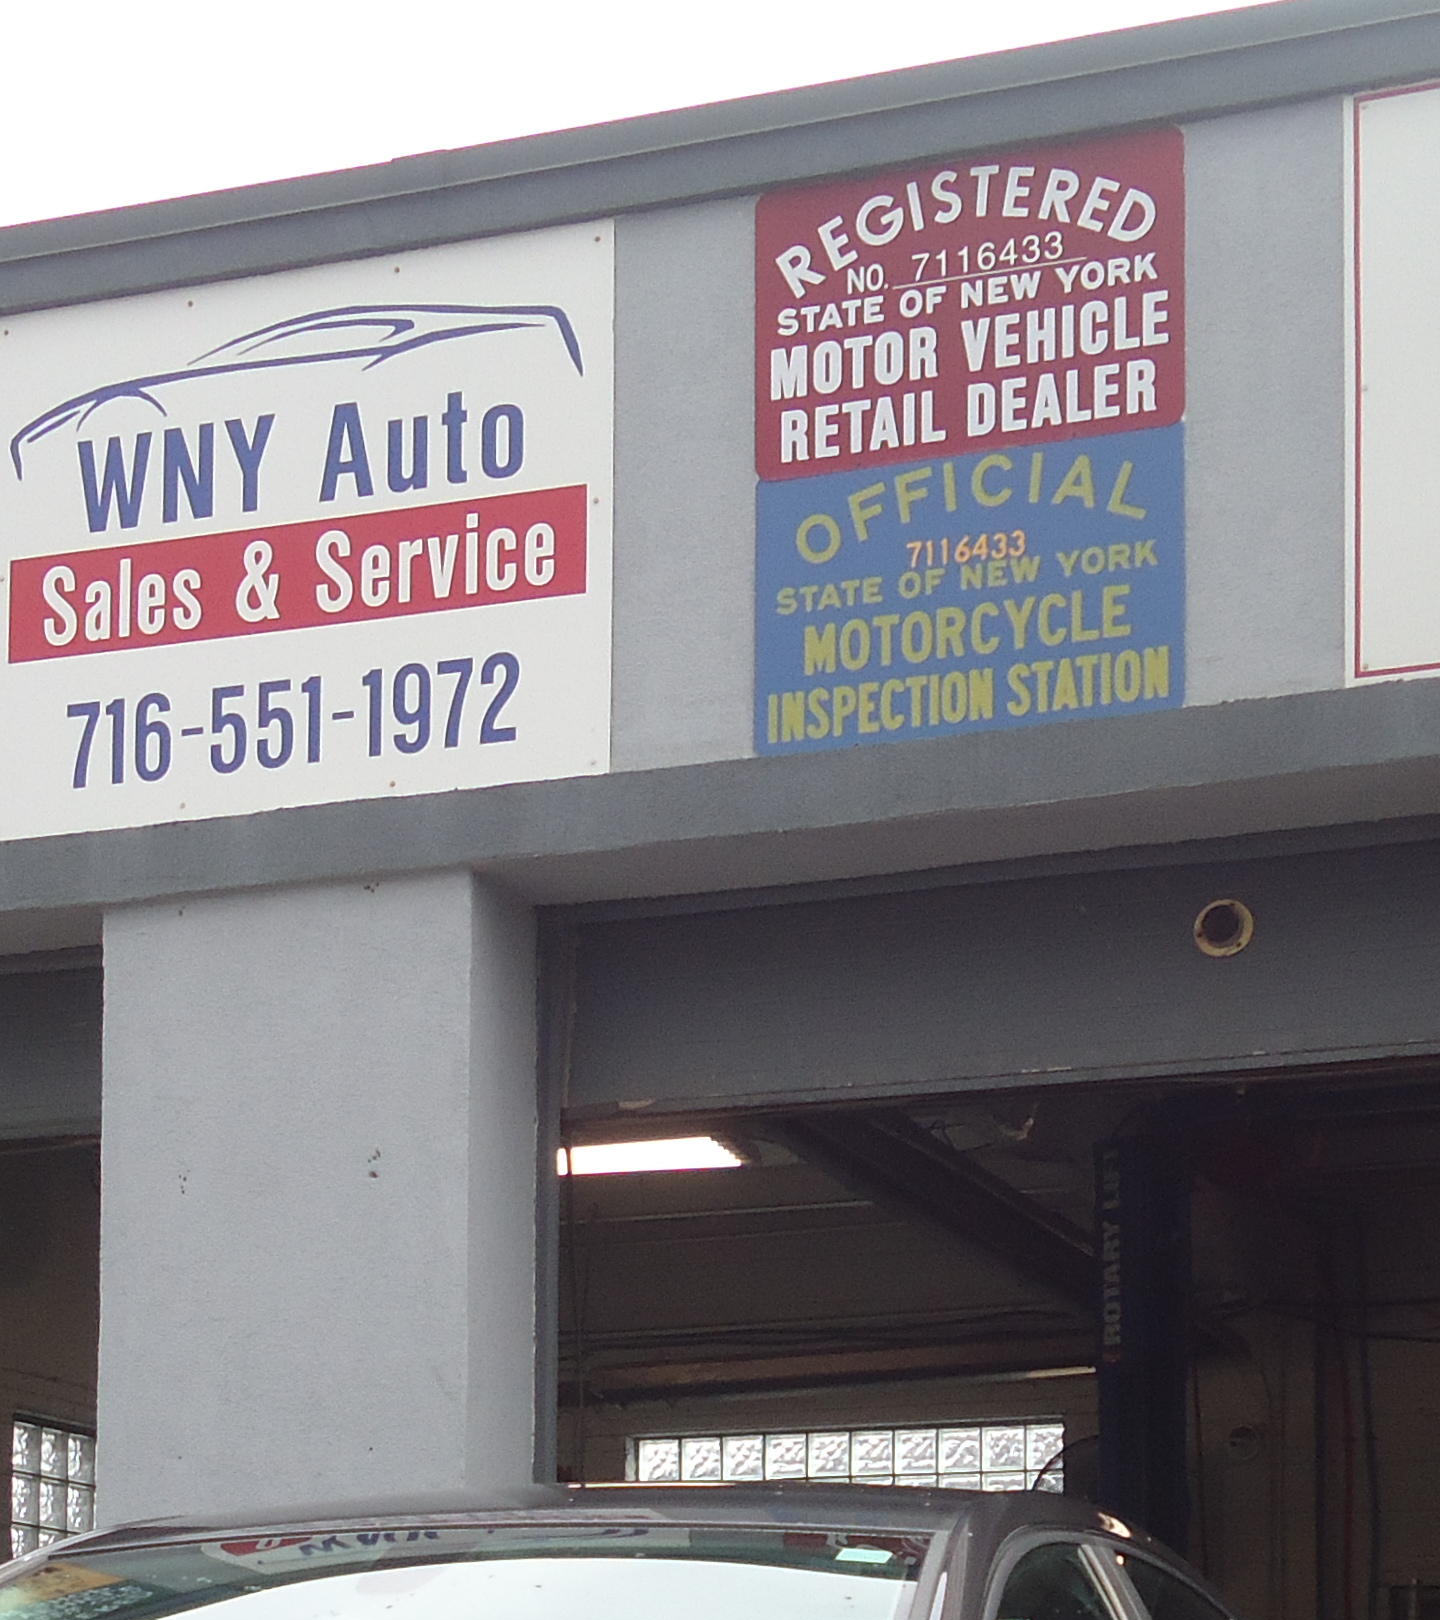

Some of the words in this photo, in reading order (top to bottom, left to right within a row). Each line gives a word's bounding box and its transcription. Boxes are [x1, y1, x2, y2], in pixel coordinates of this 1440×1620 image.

[774, 164, 1156, 299] REGISTERED
[847, 262, 890, 295] NO.
[911, 231, 1064, 283] 7116433
[770, 325, 939, 401] MOTOR
[961, 290, 1169, 373] VEHICLE
[777, 295, 884, 336] STATE
[899, 286, 943, 319] OF
[960, 271, 1039, 310] NEW
[1056, 252, 1158, 294] YORK
[77, 413, 276, 534] WNY
[319, 390, 524, 503] Auto
[780, 391, 947, 464] RETAIL
[967, 358, 1157, 437] DEALER
[796, 452, 1147, 565] OFFICIAL
[905, 529, 1027, 569] 7116433
[42, 558, 203, 647] Sales
[235, 540, 280, 623] &
[315, 512, 556, 614] Service
[776, 576, 883, 616] STATE
[897, 566, 942, 600] OF
[960, 555, 1040, 591] NEW
[1055, 539, 1158, 577] YORK
[803, 583, 1132, 677] MOTORCYCLE
[66, 651, 521, 790] 716-551-1972
[767, 665, 995, 745] INSPECTION
[1006, 646, 1169, 718] STATION
[1103, 1221, 1121, 1345] ROTARY
